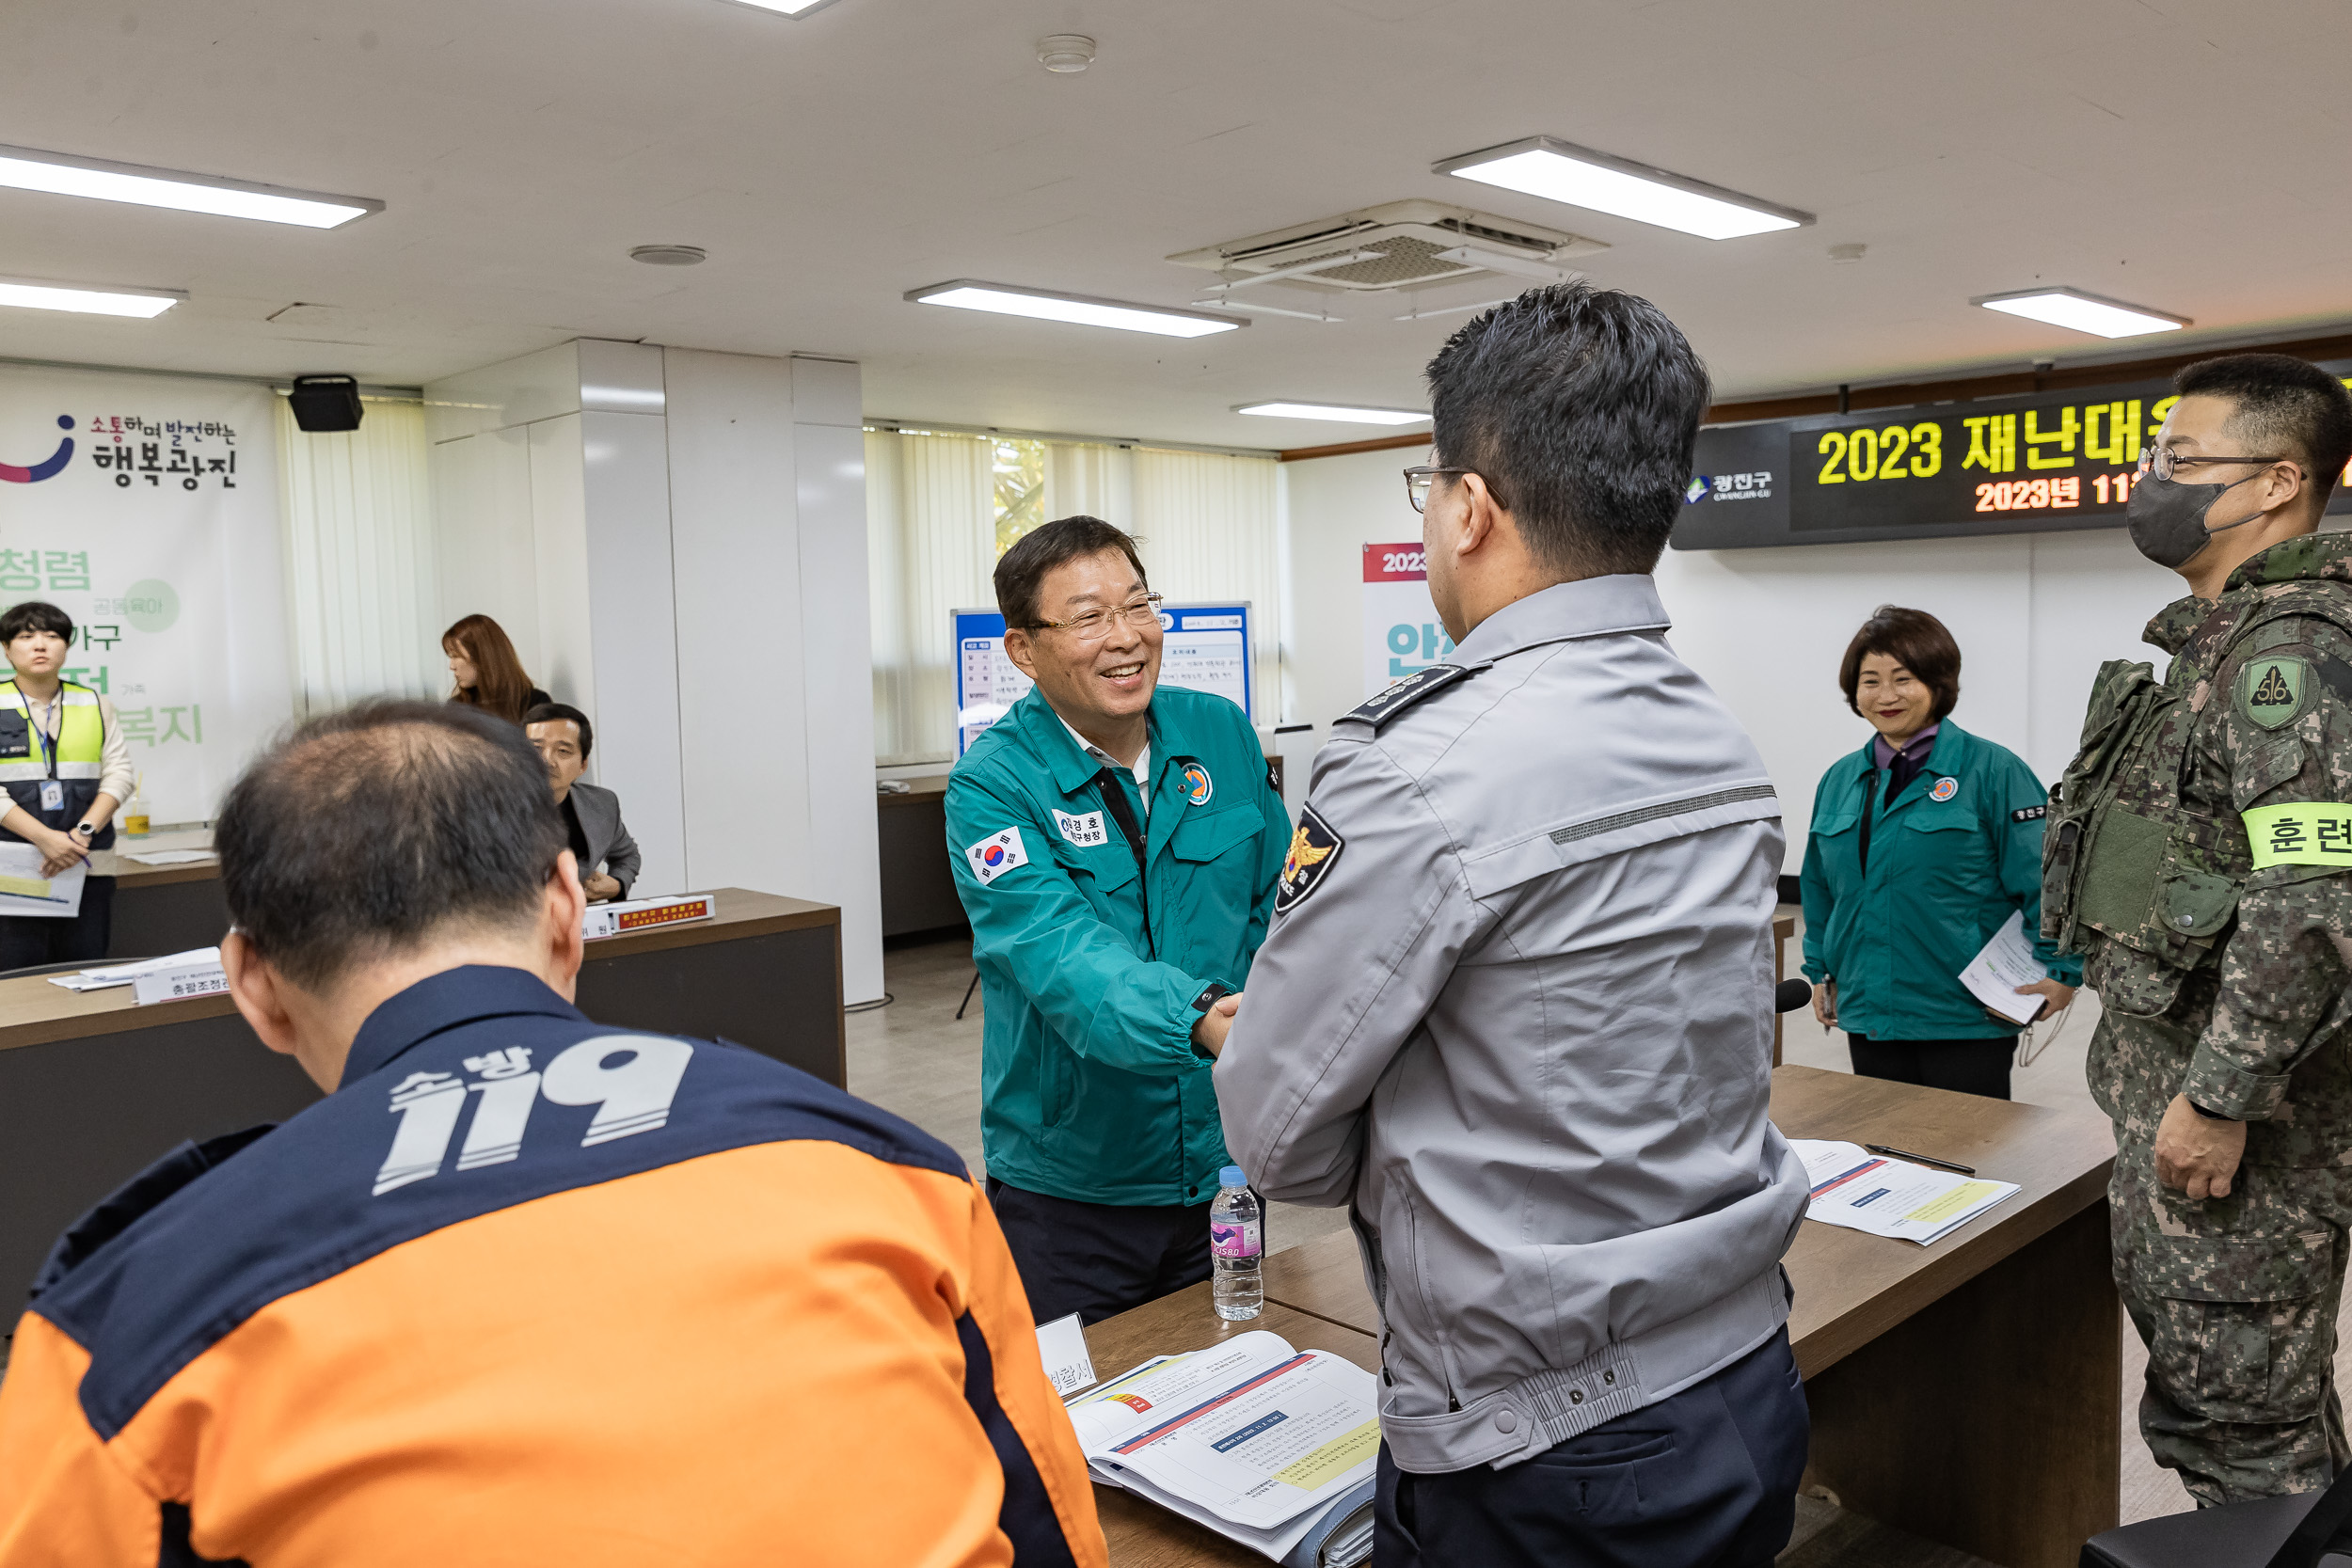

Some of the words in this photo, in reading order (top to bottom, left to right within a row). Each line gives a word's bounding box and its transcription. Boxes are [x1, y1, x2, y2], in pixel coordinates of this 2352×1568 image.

[91, 416, 162, 444] 소통하며
[166, 420, 236, 447] 발전하는
[1819, 421, 1942, 484] 2023
[92, 442, 236, 491] 행복광진
[1712, 471, 1772, 492] 광진구
[1975, 475, 2079, 513] 2023년
[2092, 471, 2149, 505] 11
[0, 548, 90, 591] 청렴
[2257, 679, 2287, 702] 56
[2270, 817, 2352, 854] 훈련
[373, 1036, 694, 1196] 119
